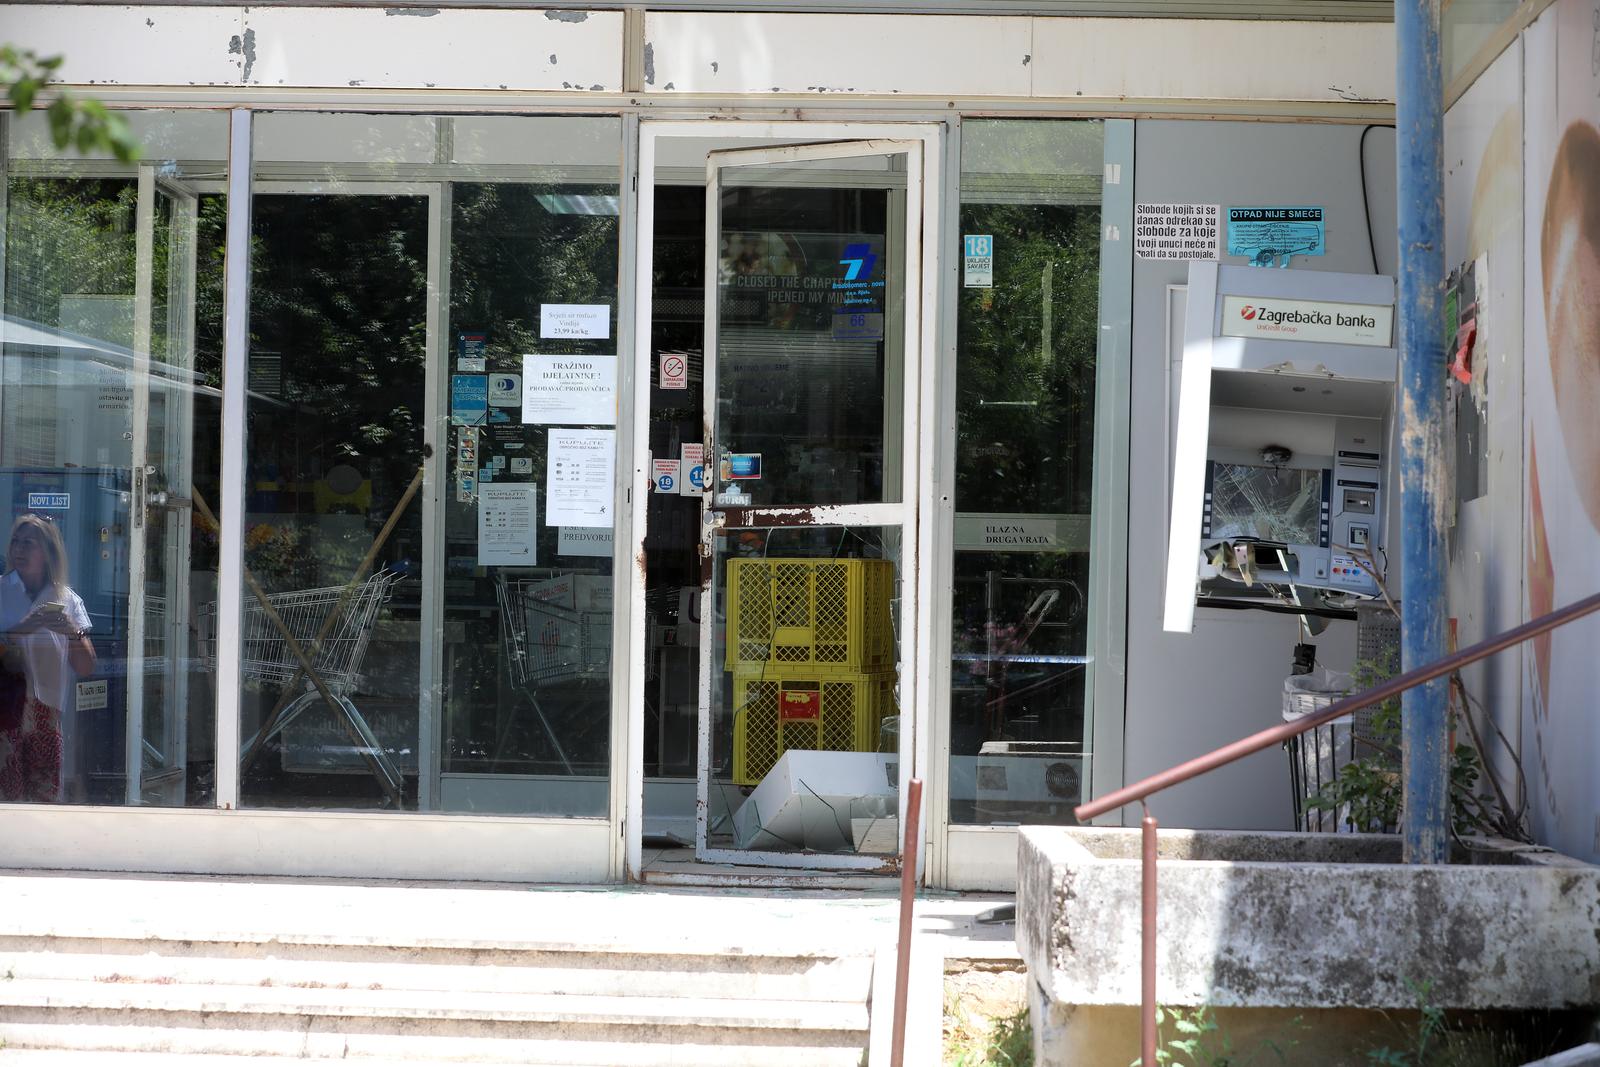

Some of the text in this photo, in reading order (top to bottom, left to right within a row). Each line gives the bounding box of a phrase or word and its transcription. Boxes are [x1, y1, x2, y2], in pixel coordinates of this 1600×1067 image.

[1137, 204, 1216, 216] Slobode kojih si se
[1231, 210, 1263, 218] OTPAD
[1265, 210, 1286, 218] NIJE
[1137, 215, 1216, 226] danas odrekao su
[1137, 226, 1216, 239] slobode za koje
[967, 237, 988, 256] 18
[1137, 238, 1157, 249] tvoji
[1158, 239, 1183, 248] unuci
[1207, 240, 1216, 249] ni
[1157, 249, 1166, 258] da
[1168, 250, 1177, 258] su
[1179, 250, 1216, 259] postojale.
[737, 275, 777, 288] CLOSED
[781, 275, 800, 288] THE
[808, 291, 824, 303] MY
[1258, 307, 1375, 328] Zagrebačka banka
[1256, 324, 1298, 334] UniCredit Group
[551, 361, 593, 370] TRAŽIMO
[660, 477, 672, 485] 18
[31, 496, 68, 506] NOVI LIST
[986, 526, 1025, 534] ULAZ NA
[986, 536, 1049, 544] DRUGA VRATA
